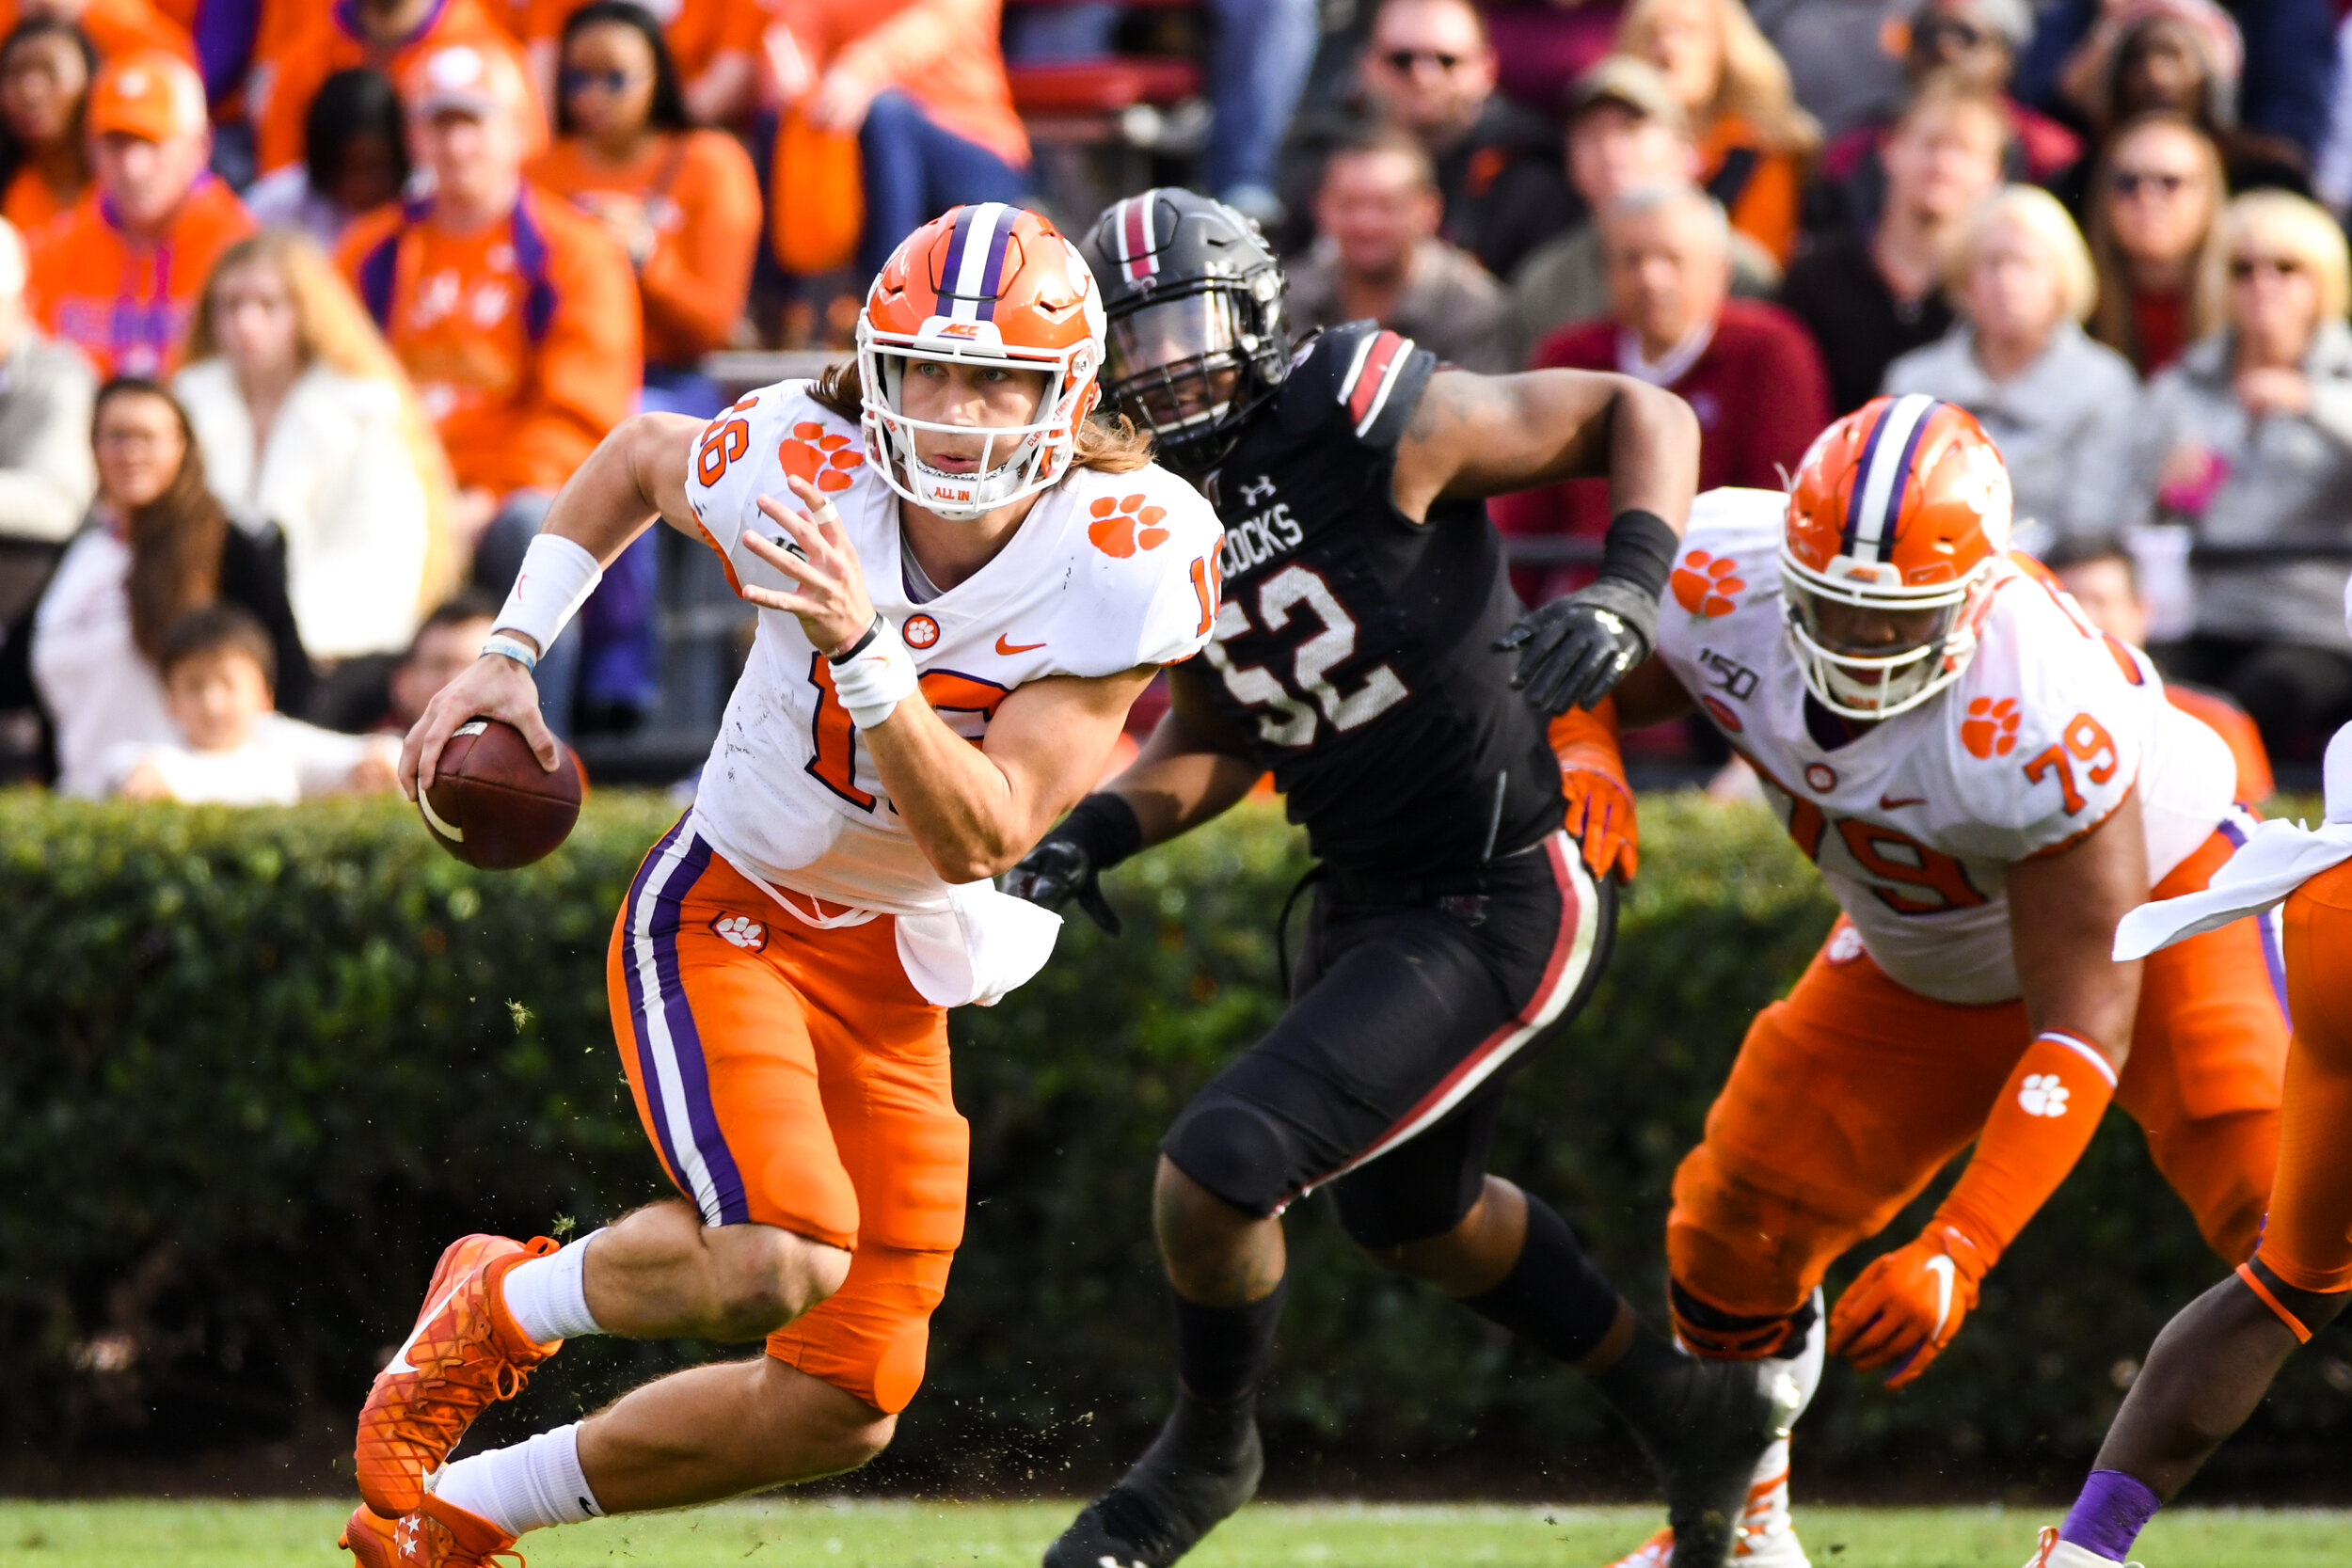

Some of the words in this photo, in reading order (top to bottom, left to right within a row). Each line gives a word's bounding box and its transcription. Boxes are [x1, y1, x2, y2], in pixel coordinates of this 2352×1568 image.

[941, 323, 980, 337] ACC
[934, 486, 955, 499] ALL
[957, 490, 970, 501] IN
[1202, 561, 1409, 749] 52
[1699, 647, 1760, 701] 150
[2022, 712, 2120, 817] 79
